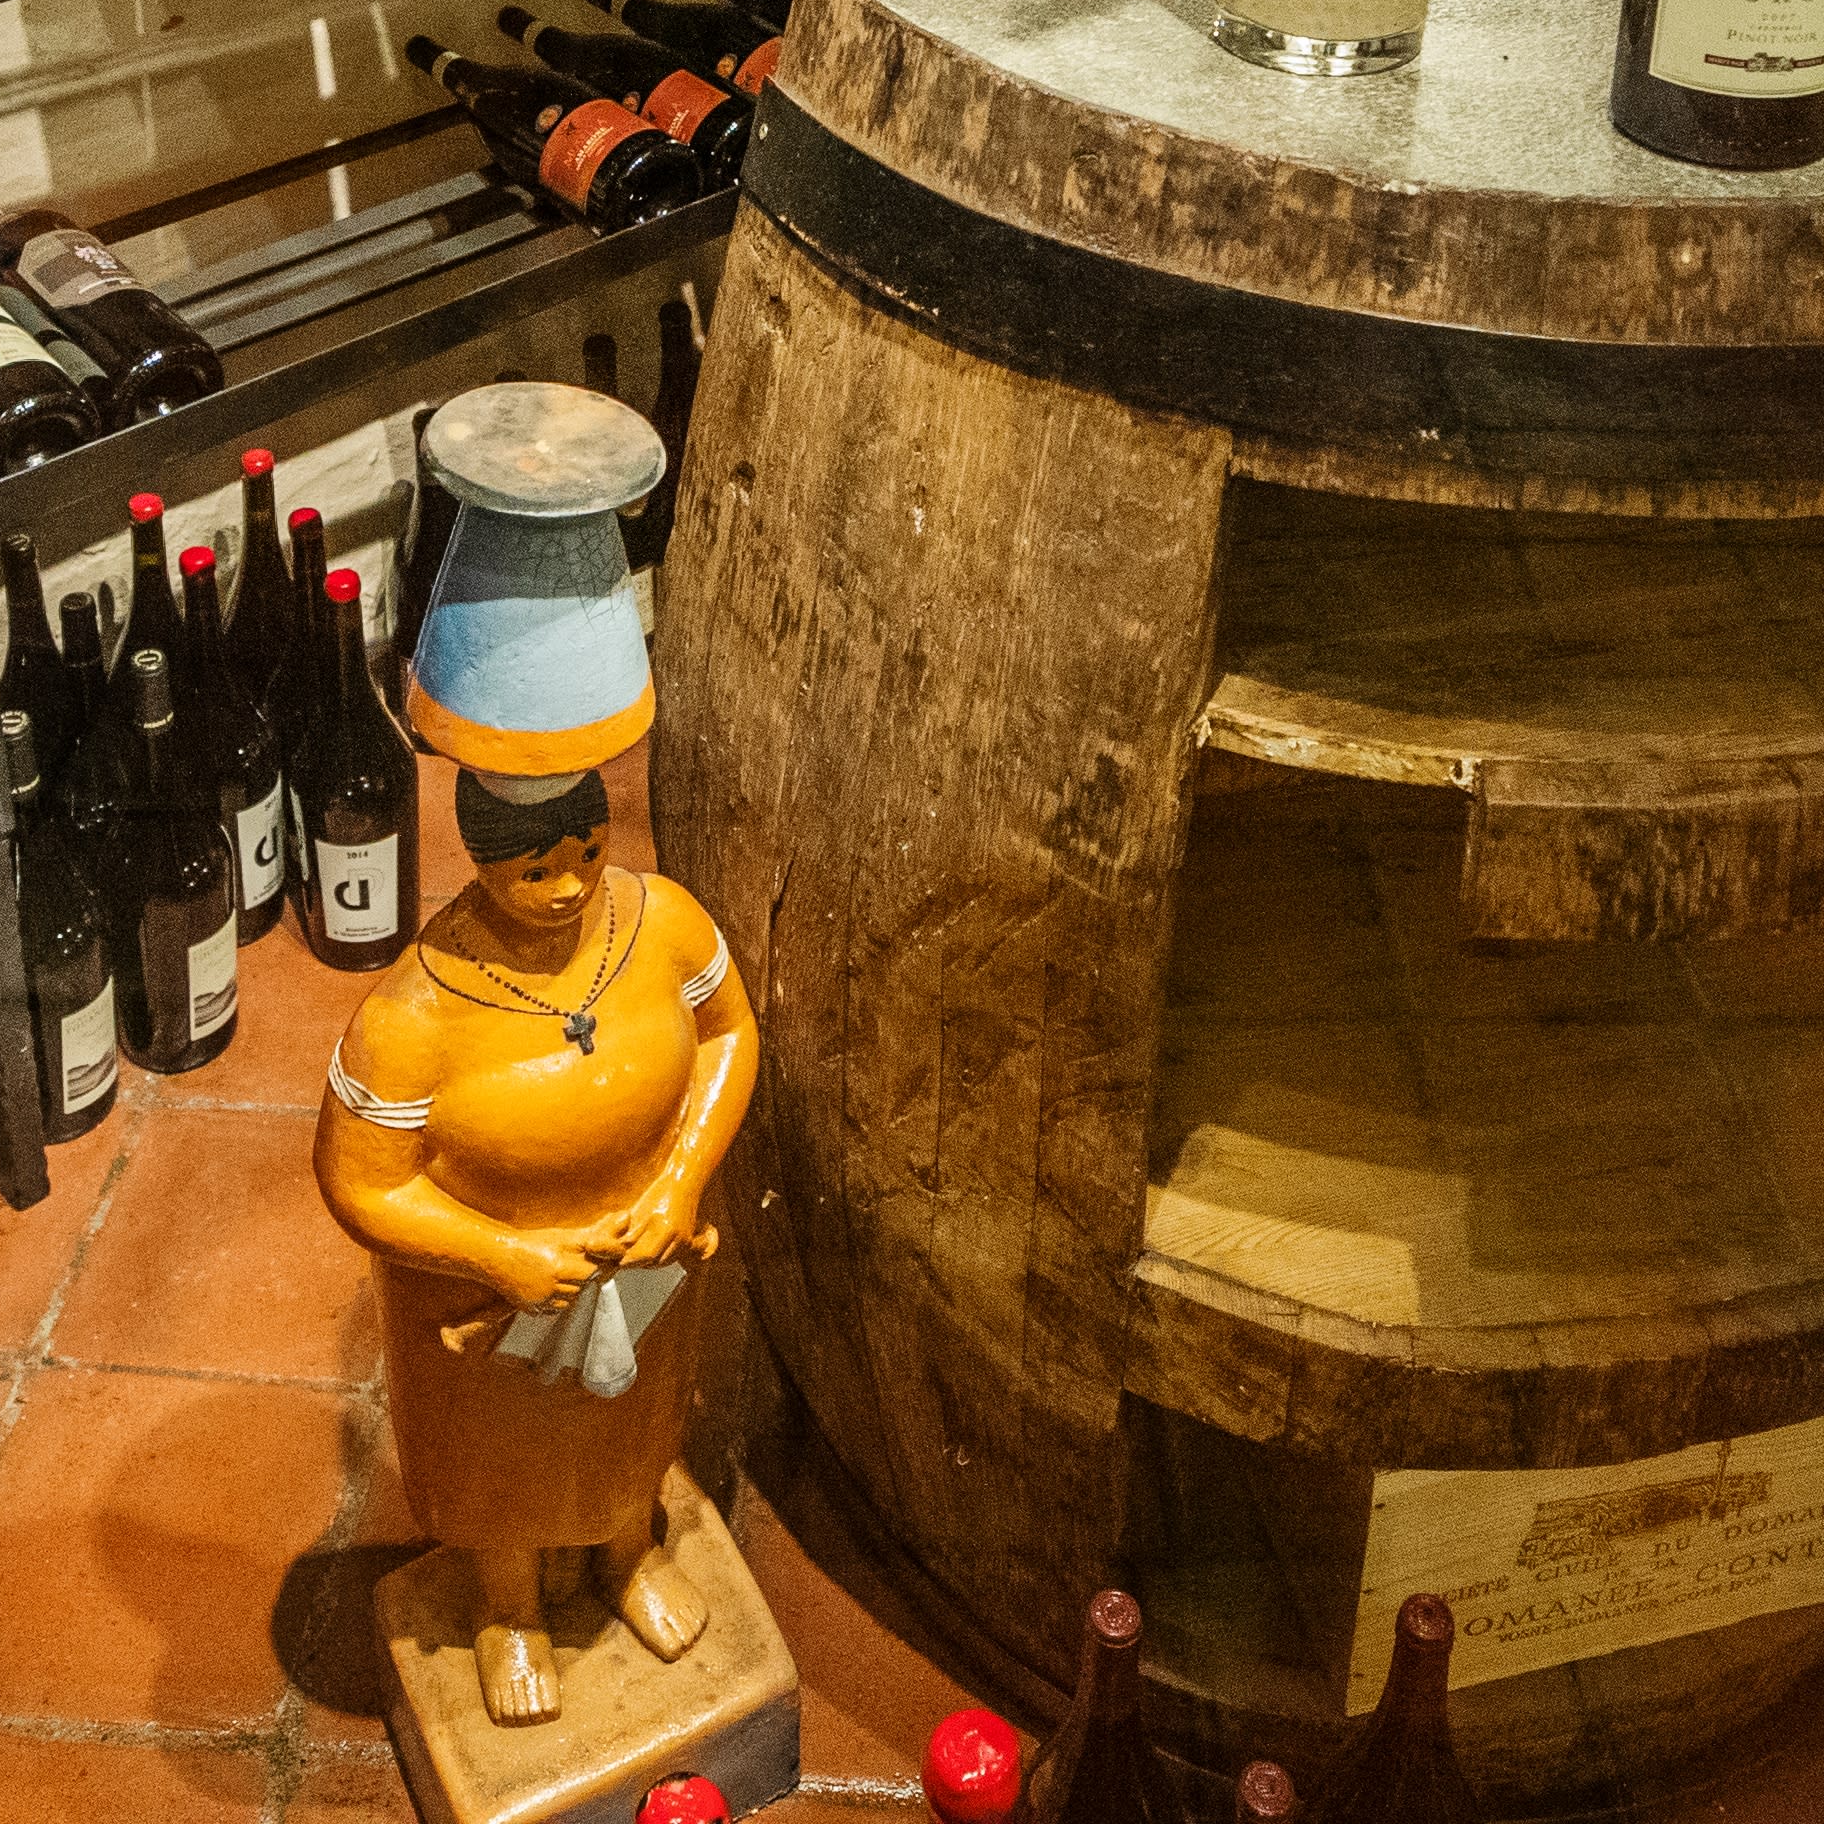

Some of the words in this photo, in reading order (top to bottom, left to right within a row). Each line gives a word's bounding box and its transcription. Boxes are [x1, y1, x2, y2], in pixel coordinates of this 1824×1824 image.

[1727, 29, 1776, 44] PINOT
[1783, 31, 1818, 43] NOIR
[1535, 1551, 1624, 1583] CIVILE
[1652, 1535, 1691, 1558] DU
